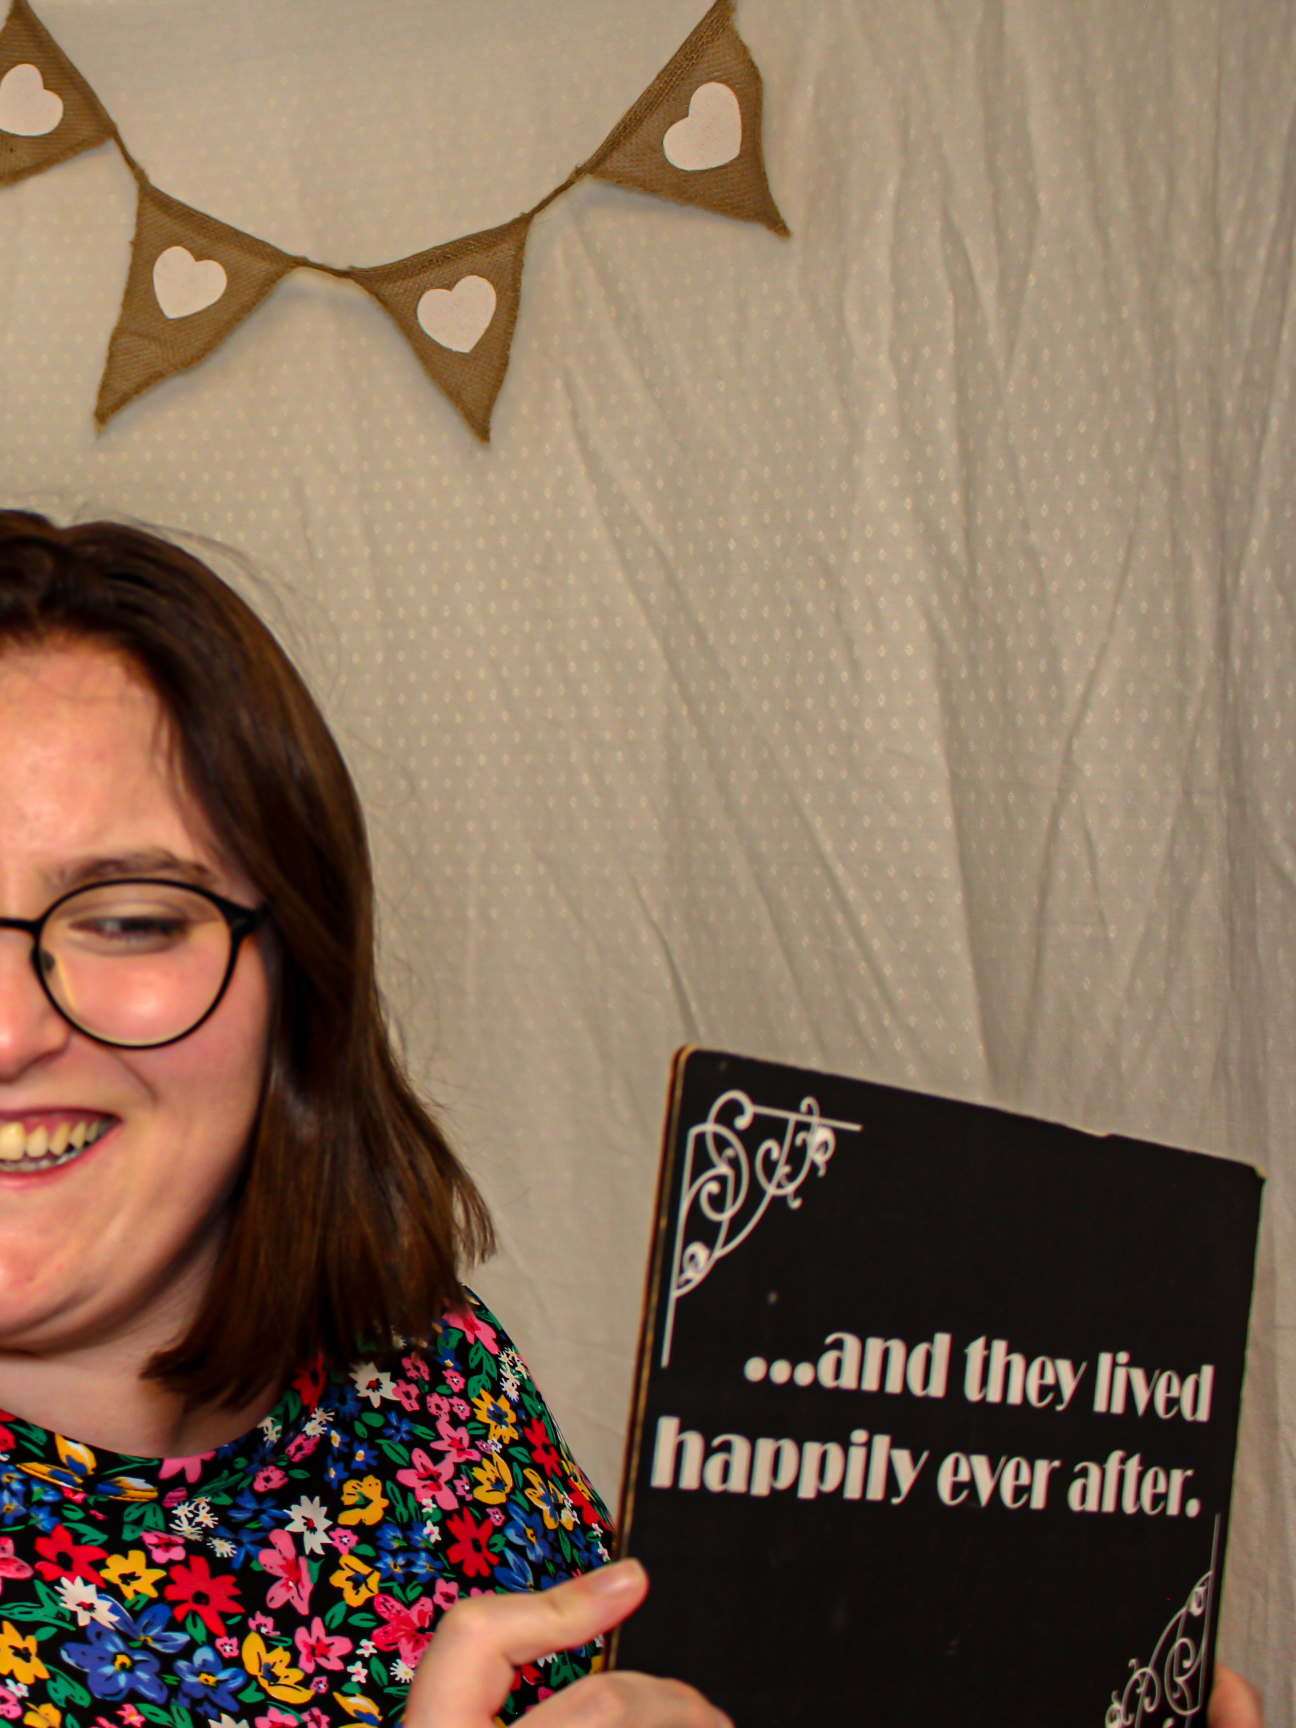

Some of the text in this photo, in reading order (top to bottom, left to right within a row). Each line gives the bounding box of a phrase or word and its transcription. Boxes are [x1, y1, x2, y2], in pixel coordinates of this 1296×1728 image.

[964, 1335, 1087, 1411] they
[1093, 1351, 1214, 1422] lived
[650, 1416, 1200, 1518] happily ever after.
